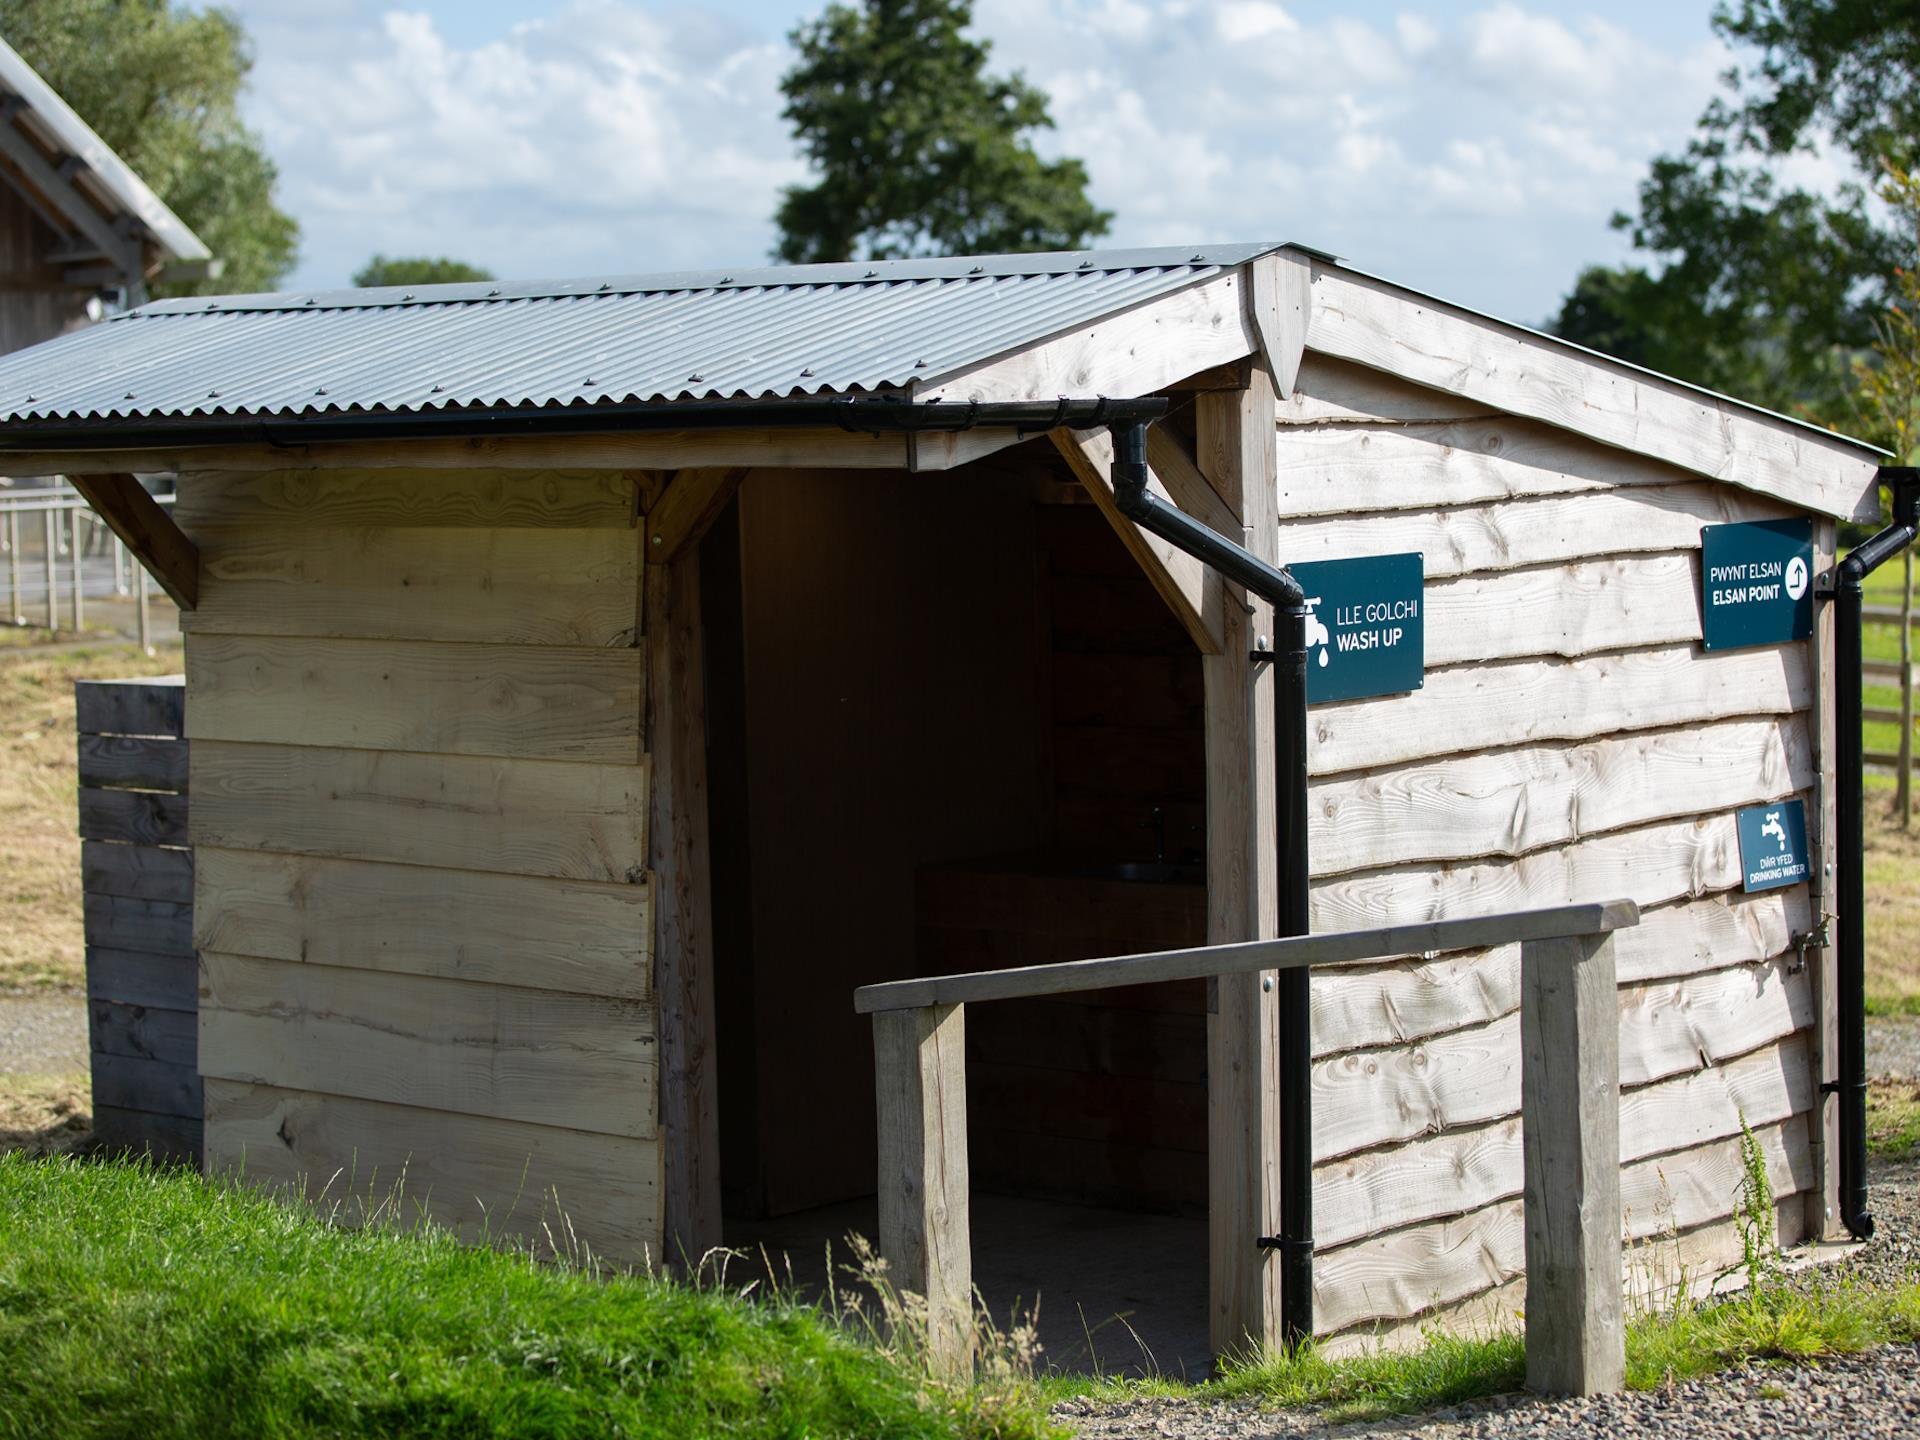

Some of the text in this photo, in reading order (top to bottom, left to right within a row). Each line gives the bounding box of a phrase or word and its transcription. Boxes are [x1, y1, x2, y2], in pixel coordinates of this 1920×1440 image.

[1710, 561, 1782, 582] PWYNT ELSAN
[1712, 584, 1780, 606] ELSAN POINT
[1336, 600, 1418, 626] LLE GOLCHI
[1336, 627, 1403, 652] WASH UP
[1776, 853, 1793, 866] YFED
[1749, 863, 1806, 884] DRINKING WATER
